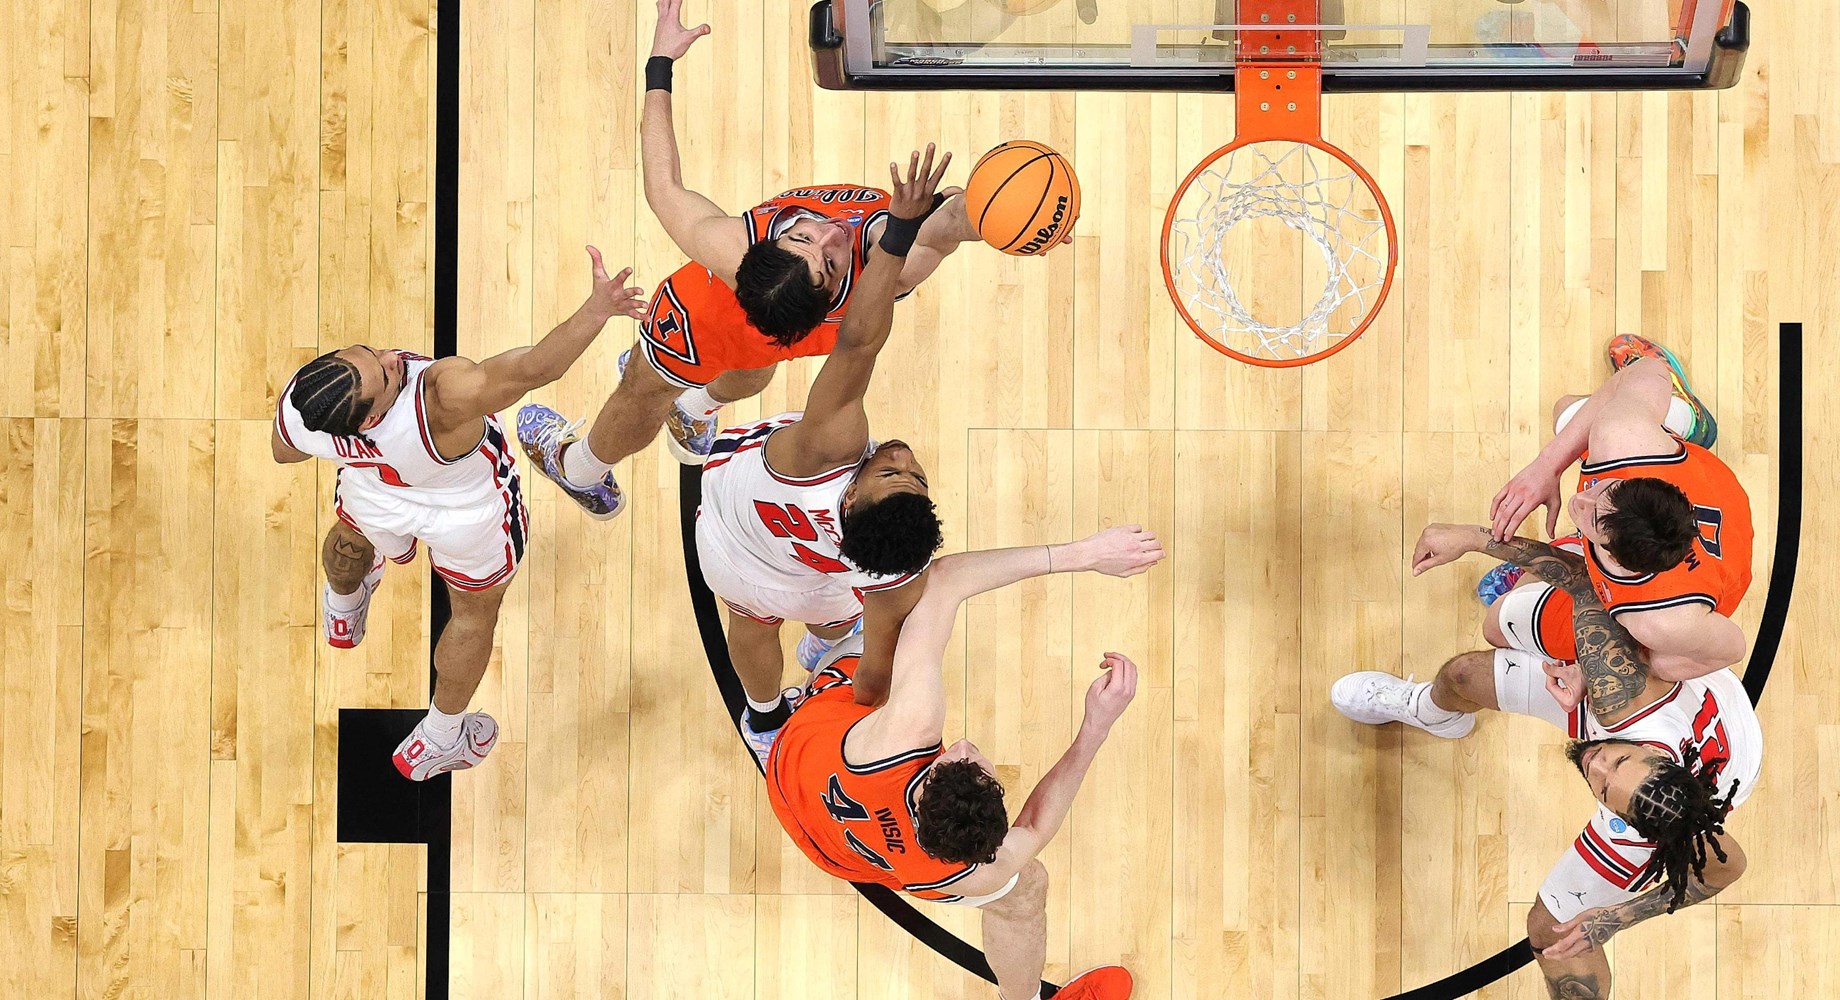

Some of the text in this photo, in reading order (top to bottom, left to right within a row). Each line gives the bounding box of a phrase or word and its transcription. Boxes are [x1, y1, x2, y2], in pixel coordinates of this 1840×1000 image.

[1014, 195, 1068, 254] Wilson
[752, 498, 853, 575] 24
[819, 772, 896, 872] 44
[873, 806, 906, 855] IVISIC
